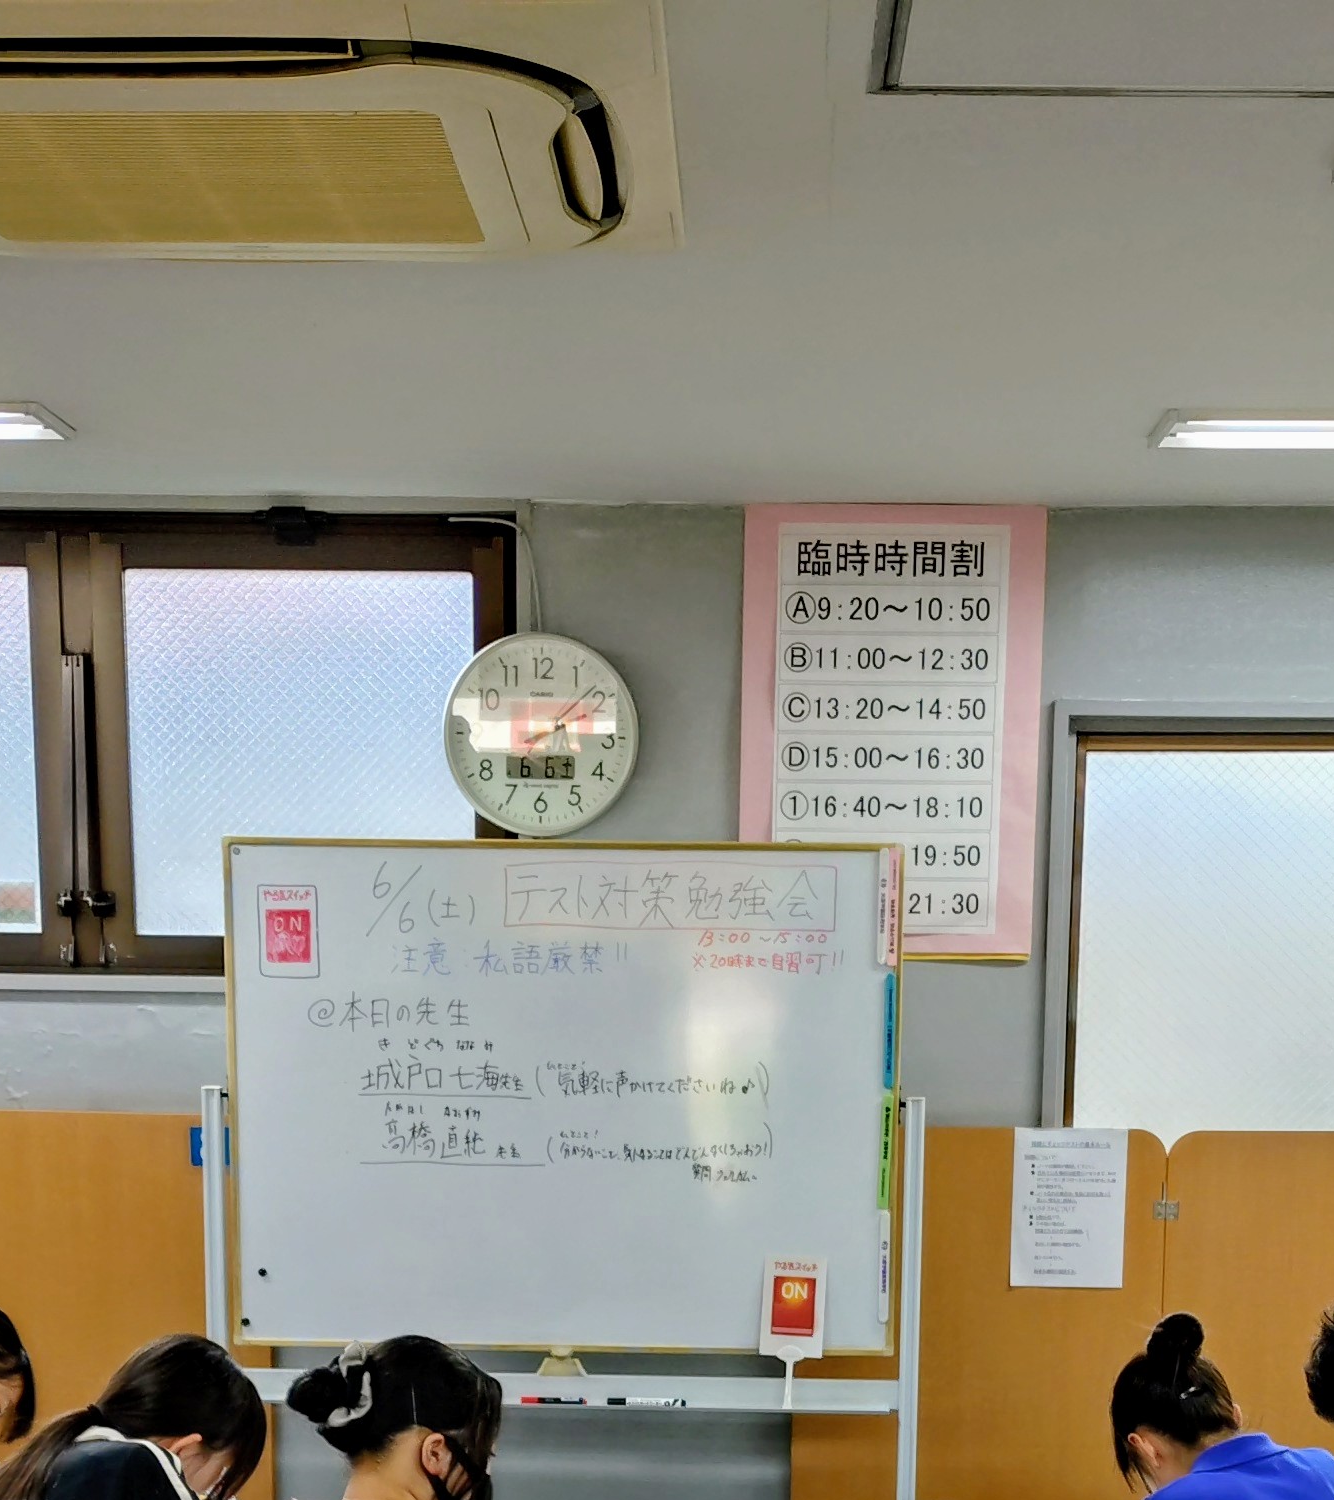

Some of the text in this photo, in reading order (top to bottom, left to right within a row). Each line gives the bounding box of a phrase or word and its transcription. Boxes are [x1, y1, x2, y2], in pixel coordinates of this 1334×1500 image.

[797, 540, 984, 577] 臨時時間割
[503, 665, 518, 687] 11
[533, 657, 554, 680] 12
[572, 666, 578, 688] 1
[479, 688, 500, 711] 10
[592, 691, 606, 713] 2
[601, 729, 615, 749] 3
[479, 759, 494, 781] 8
[591, 761, 605, 781] 4
[505, 784, 518, 806] 7
[534, 791, 548, 813] 6
[567, 785, 581, 806] 5
[511, 869, 819, 929] テスト対策勉強会
[781, 1281, 809, 1299] ON
